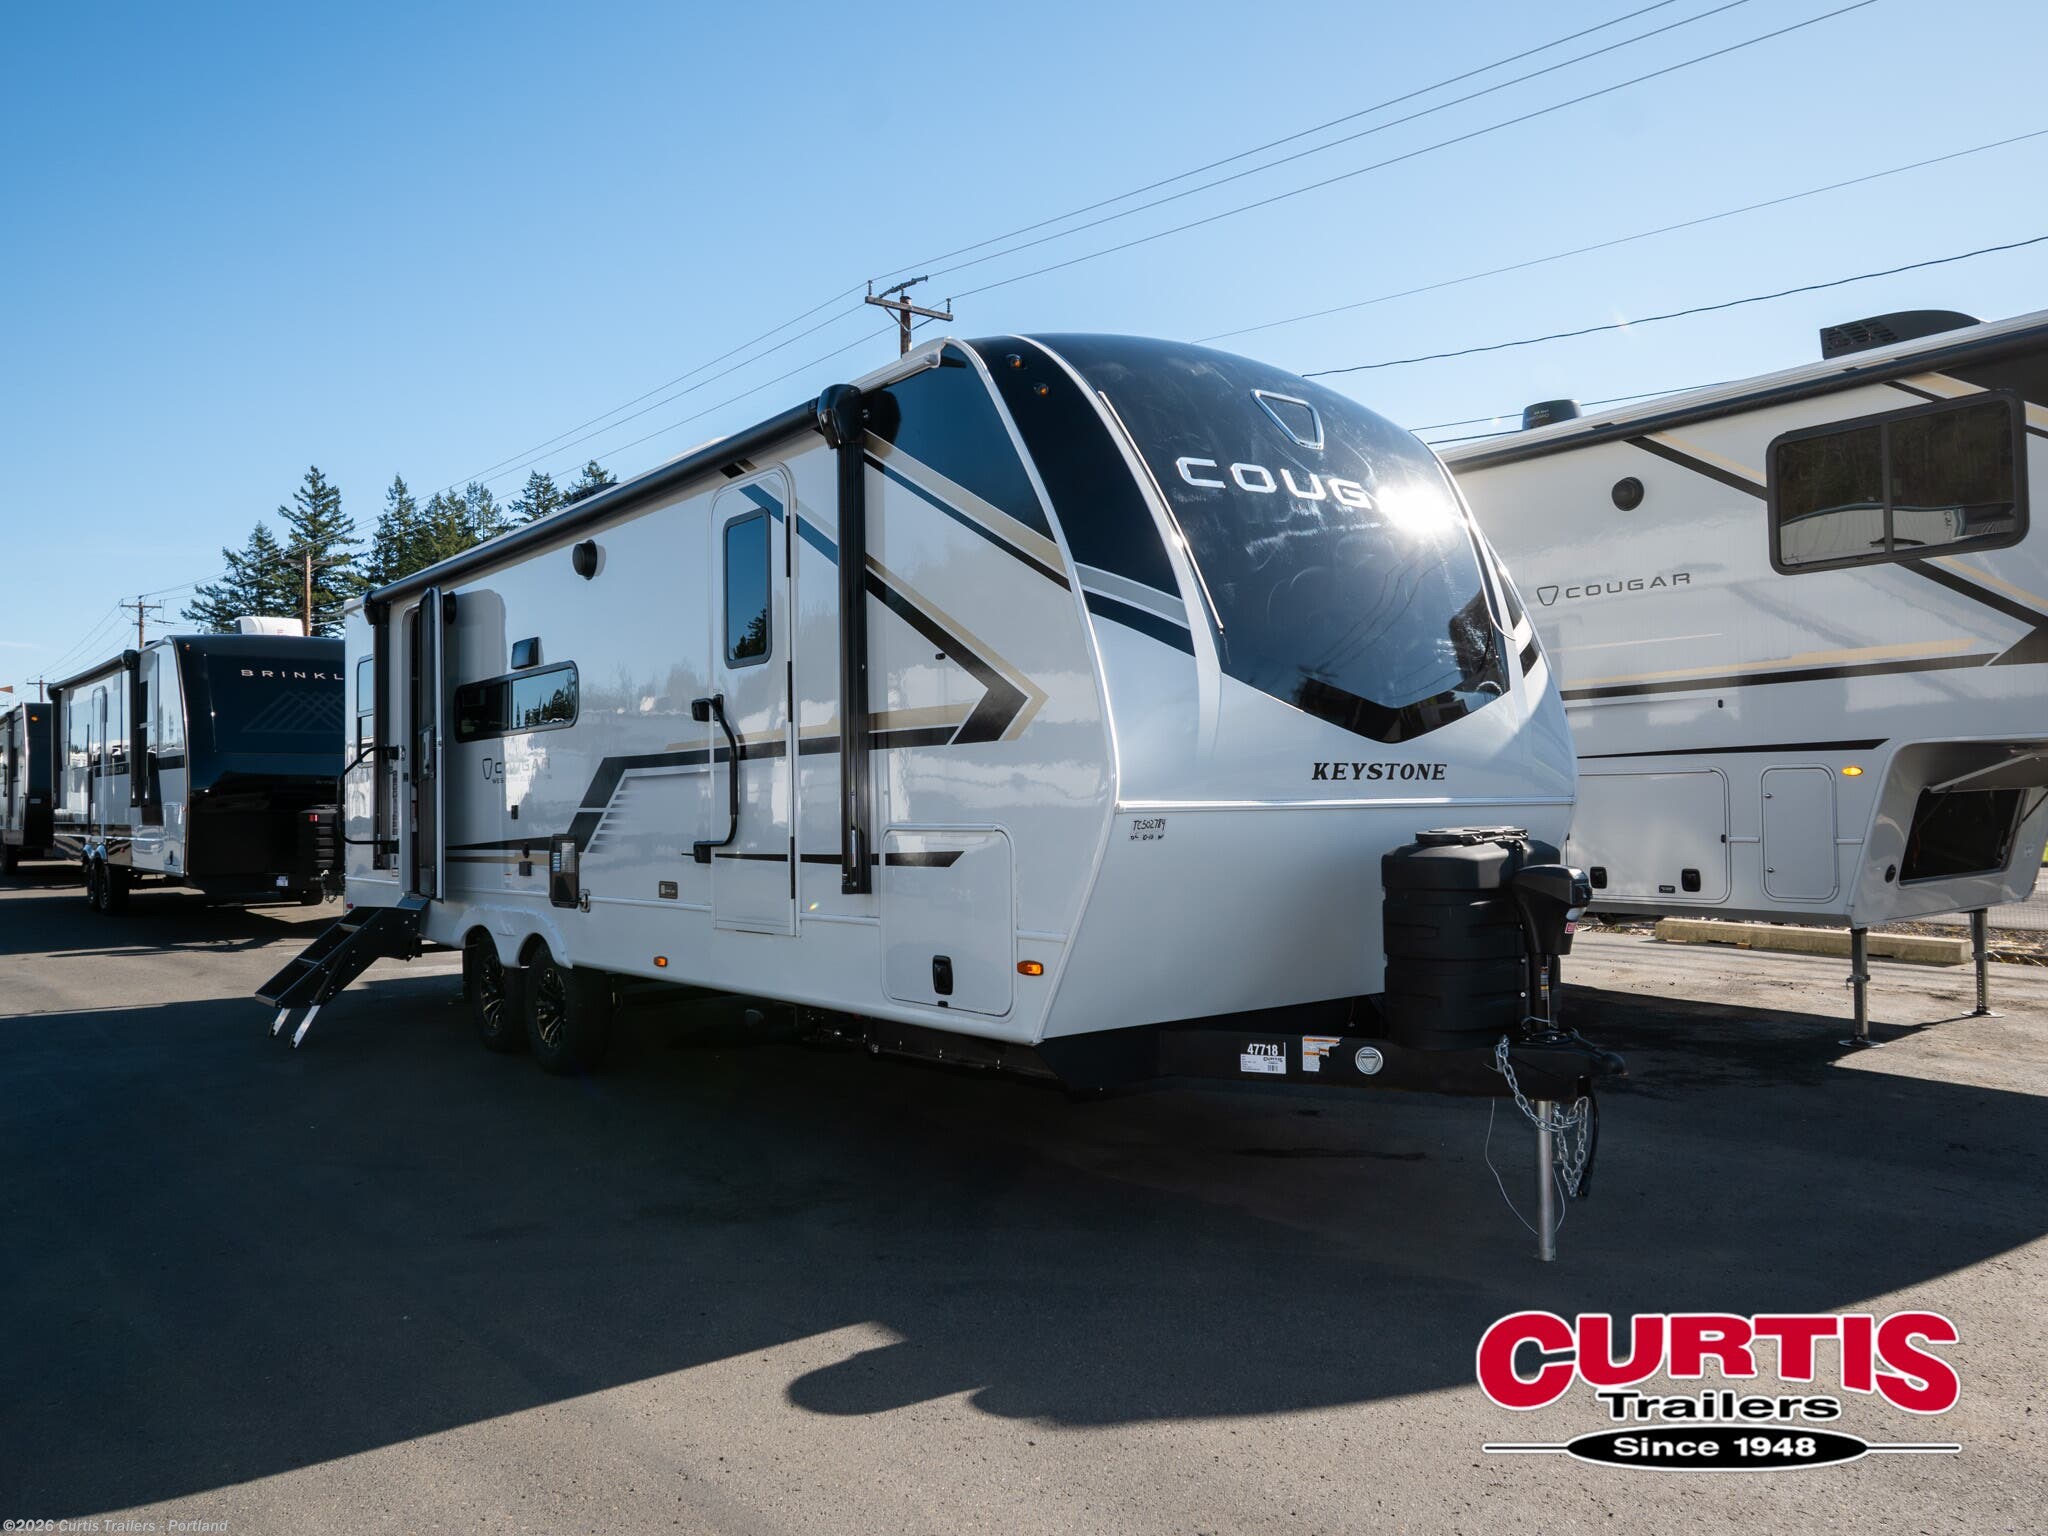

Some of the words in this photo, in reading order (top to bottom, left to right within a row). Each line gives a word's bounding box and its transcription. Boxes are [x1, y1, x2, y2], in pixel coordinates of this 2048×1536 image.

[1175, 456, 1396, 512] COUG
[1566, 573, 1690, 598] COUGAR
[241, 669, 344, 681] BRINKL
[1311, 762, 1447, 781] KEYSTONE
[1247, 1043, 1278, 1056] 47718
